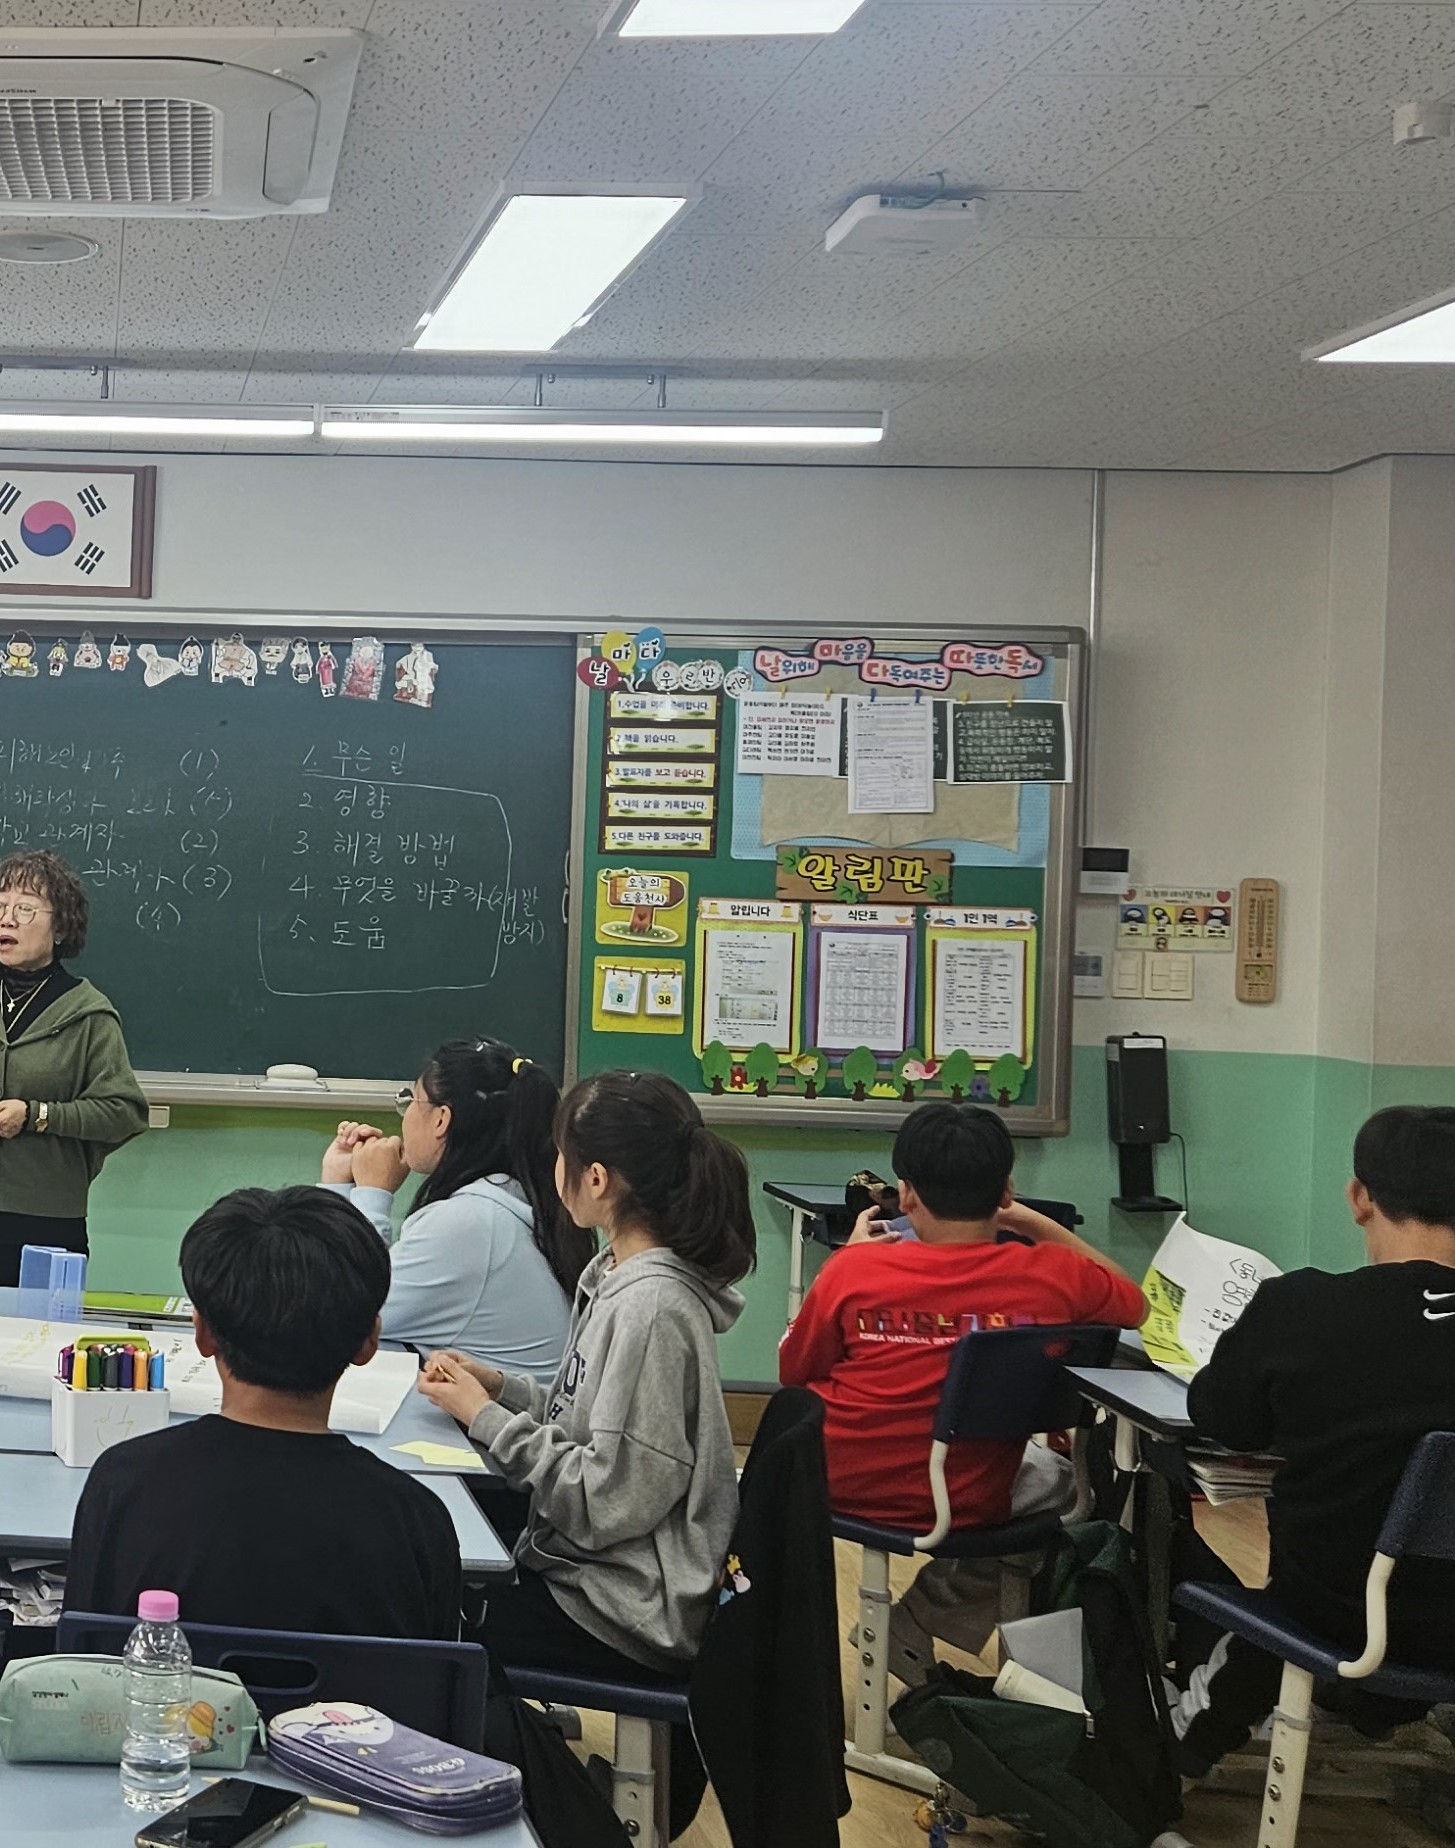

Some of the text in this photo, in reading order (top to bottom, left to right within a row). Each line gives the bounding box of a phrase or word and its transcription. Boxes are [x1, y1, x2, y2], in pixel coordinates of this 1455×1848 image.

[819, 642, 868, 661] 마음을
[866, 662, 946, 685] 다독여주는
[179, 748, 220, 780] (1)
[331, 740, 372, 777] 무슨
[389, 742, 406, 775] 일
[333, 785, 392, 819] 영향
[180, 828, 219, 856] (2)
[333, 830, 384, 866] 해결
[397, 832, 455, 871] 방법
[182, 863, 233, 901] (3)
[628, 877, 660, 888] 오늘의
[797, 853, 930, 894] 알림판
[332, 874, 396, 907] 무엇을
[623, 891, 665, 904] 도움천사
[847, 909, 879, 922] 식단표
[331, 915, 386, 950] 도움
[616, 994, 623, 1003] 8
[657, 995, 671, 1005] 38
[859, 1333, 931, 1345] KOREA NATIONAL
